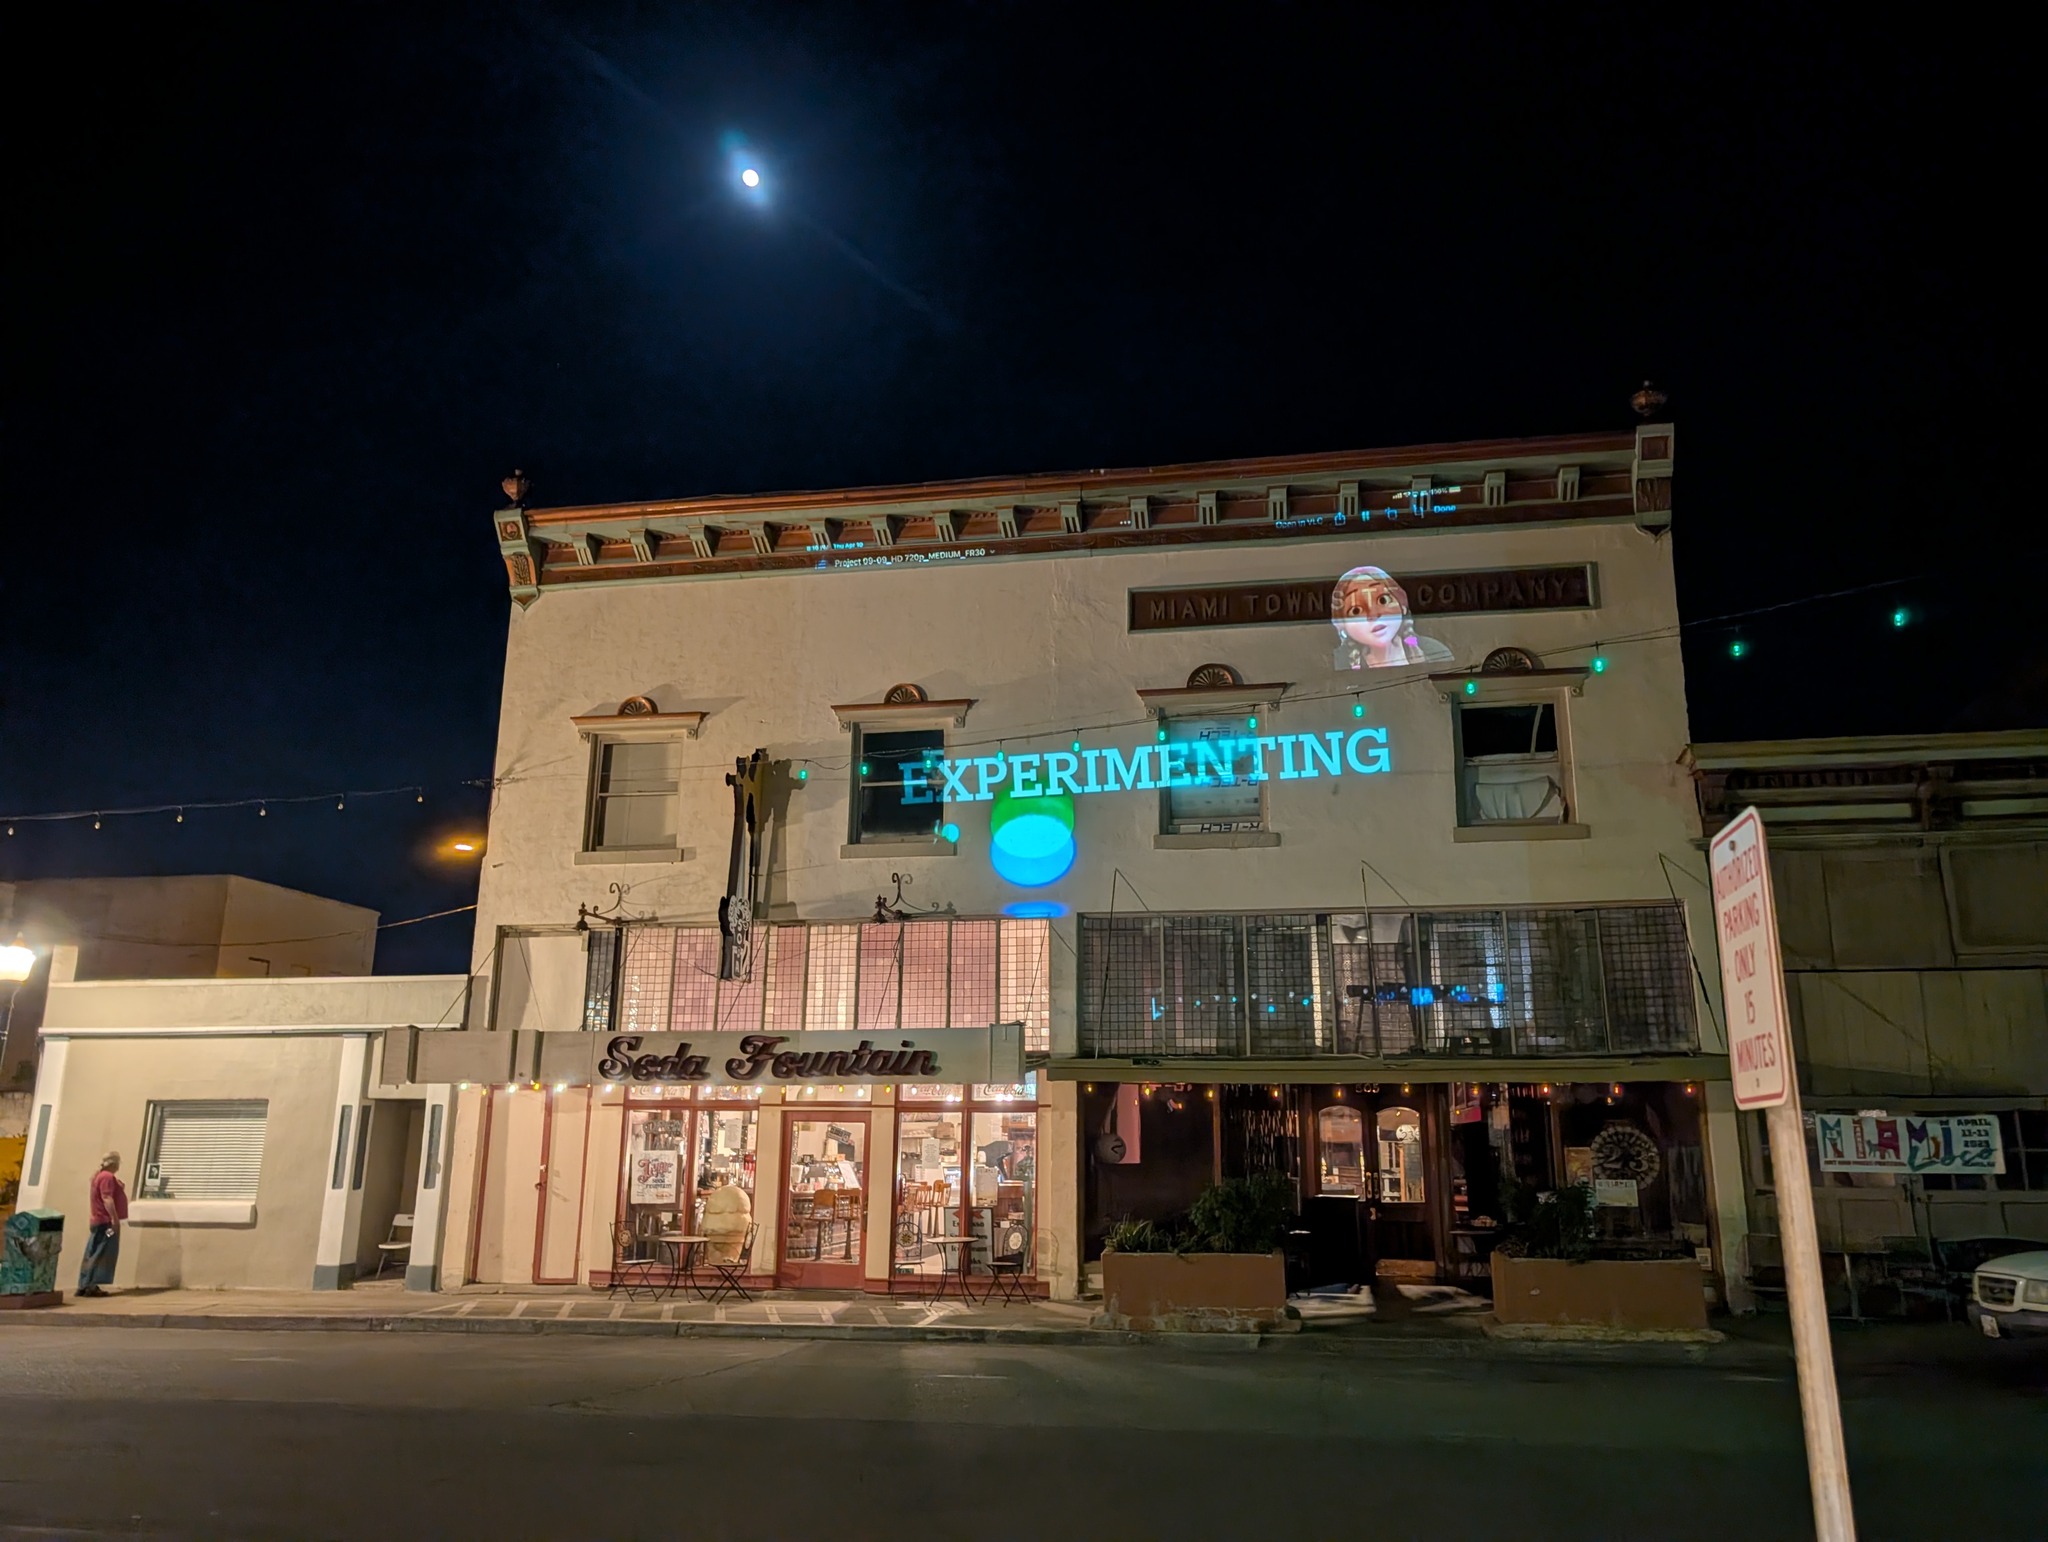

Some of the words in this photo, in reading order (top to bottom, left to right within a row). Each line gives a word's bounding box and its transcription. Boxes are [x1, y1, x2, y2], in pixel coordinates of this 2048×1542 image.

[1275, 520, 1296, 529] Open
[1307, 516, 1324, 526] VLC
[1433, 504, 1457, 514] Done
[834, 558, 862, 569] Project
[904, 547, 986, 563] 720p_MEDIUM_FR30
[845, 542, 856, 550] Apr
[1150, 593, 1229, 621] MIAMI
[1249, 585, 1401, 617] TOWNSITE
[1417, 576, 1567, 606] COMPANY
[899, 727, 1392, 805] EXPERIMENTING
[1723, 891, 1760, 944] PARKING
[1733, 942, 1756, 984] ONLY
[1744, 990, 1756, 1024] 15
[598, 1035, 711, 1081] Soda
[725, 1034, 942, 1081] Fountain
[1735, 1032, 1776, 1074] MINUTES
[1957, 1119, 1992, 1127] APRIL
